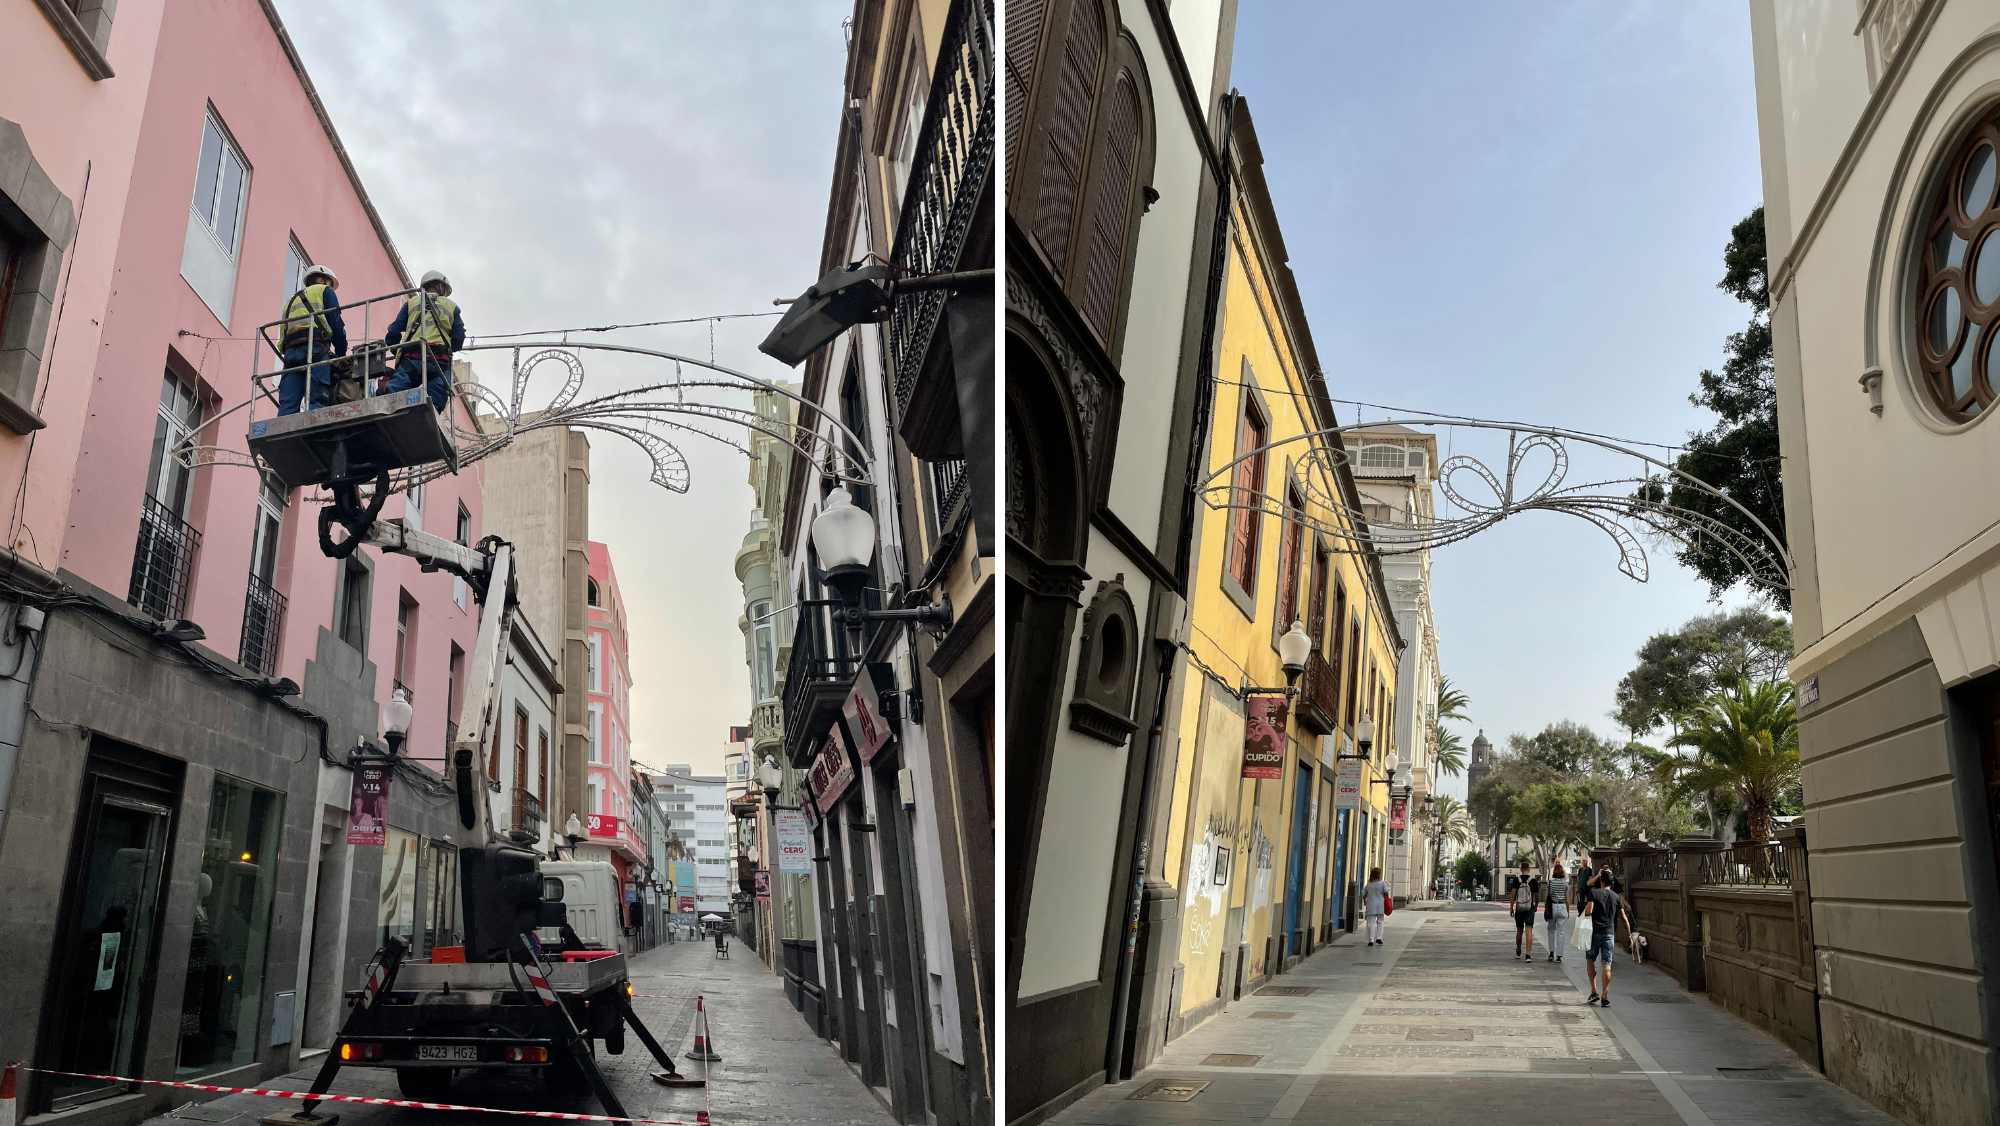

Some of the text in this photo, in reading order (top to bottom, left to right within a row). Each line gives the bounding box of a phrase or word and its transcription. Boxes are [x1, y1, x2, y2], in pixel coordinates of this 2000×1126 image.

[1246, 753, 1280, 762] CUPIDO
[783, 846, 804, 854] CERO
[421, 1046, 475, 1059] 9423 HGZ
